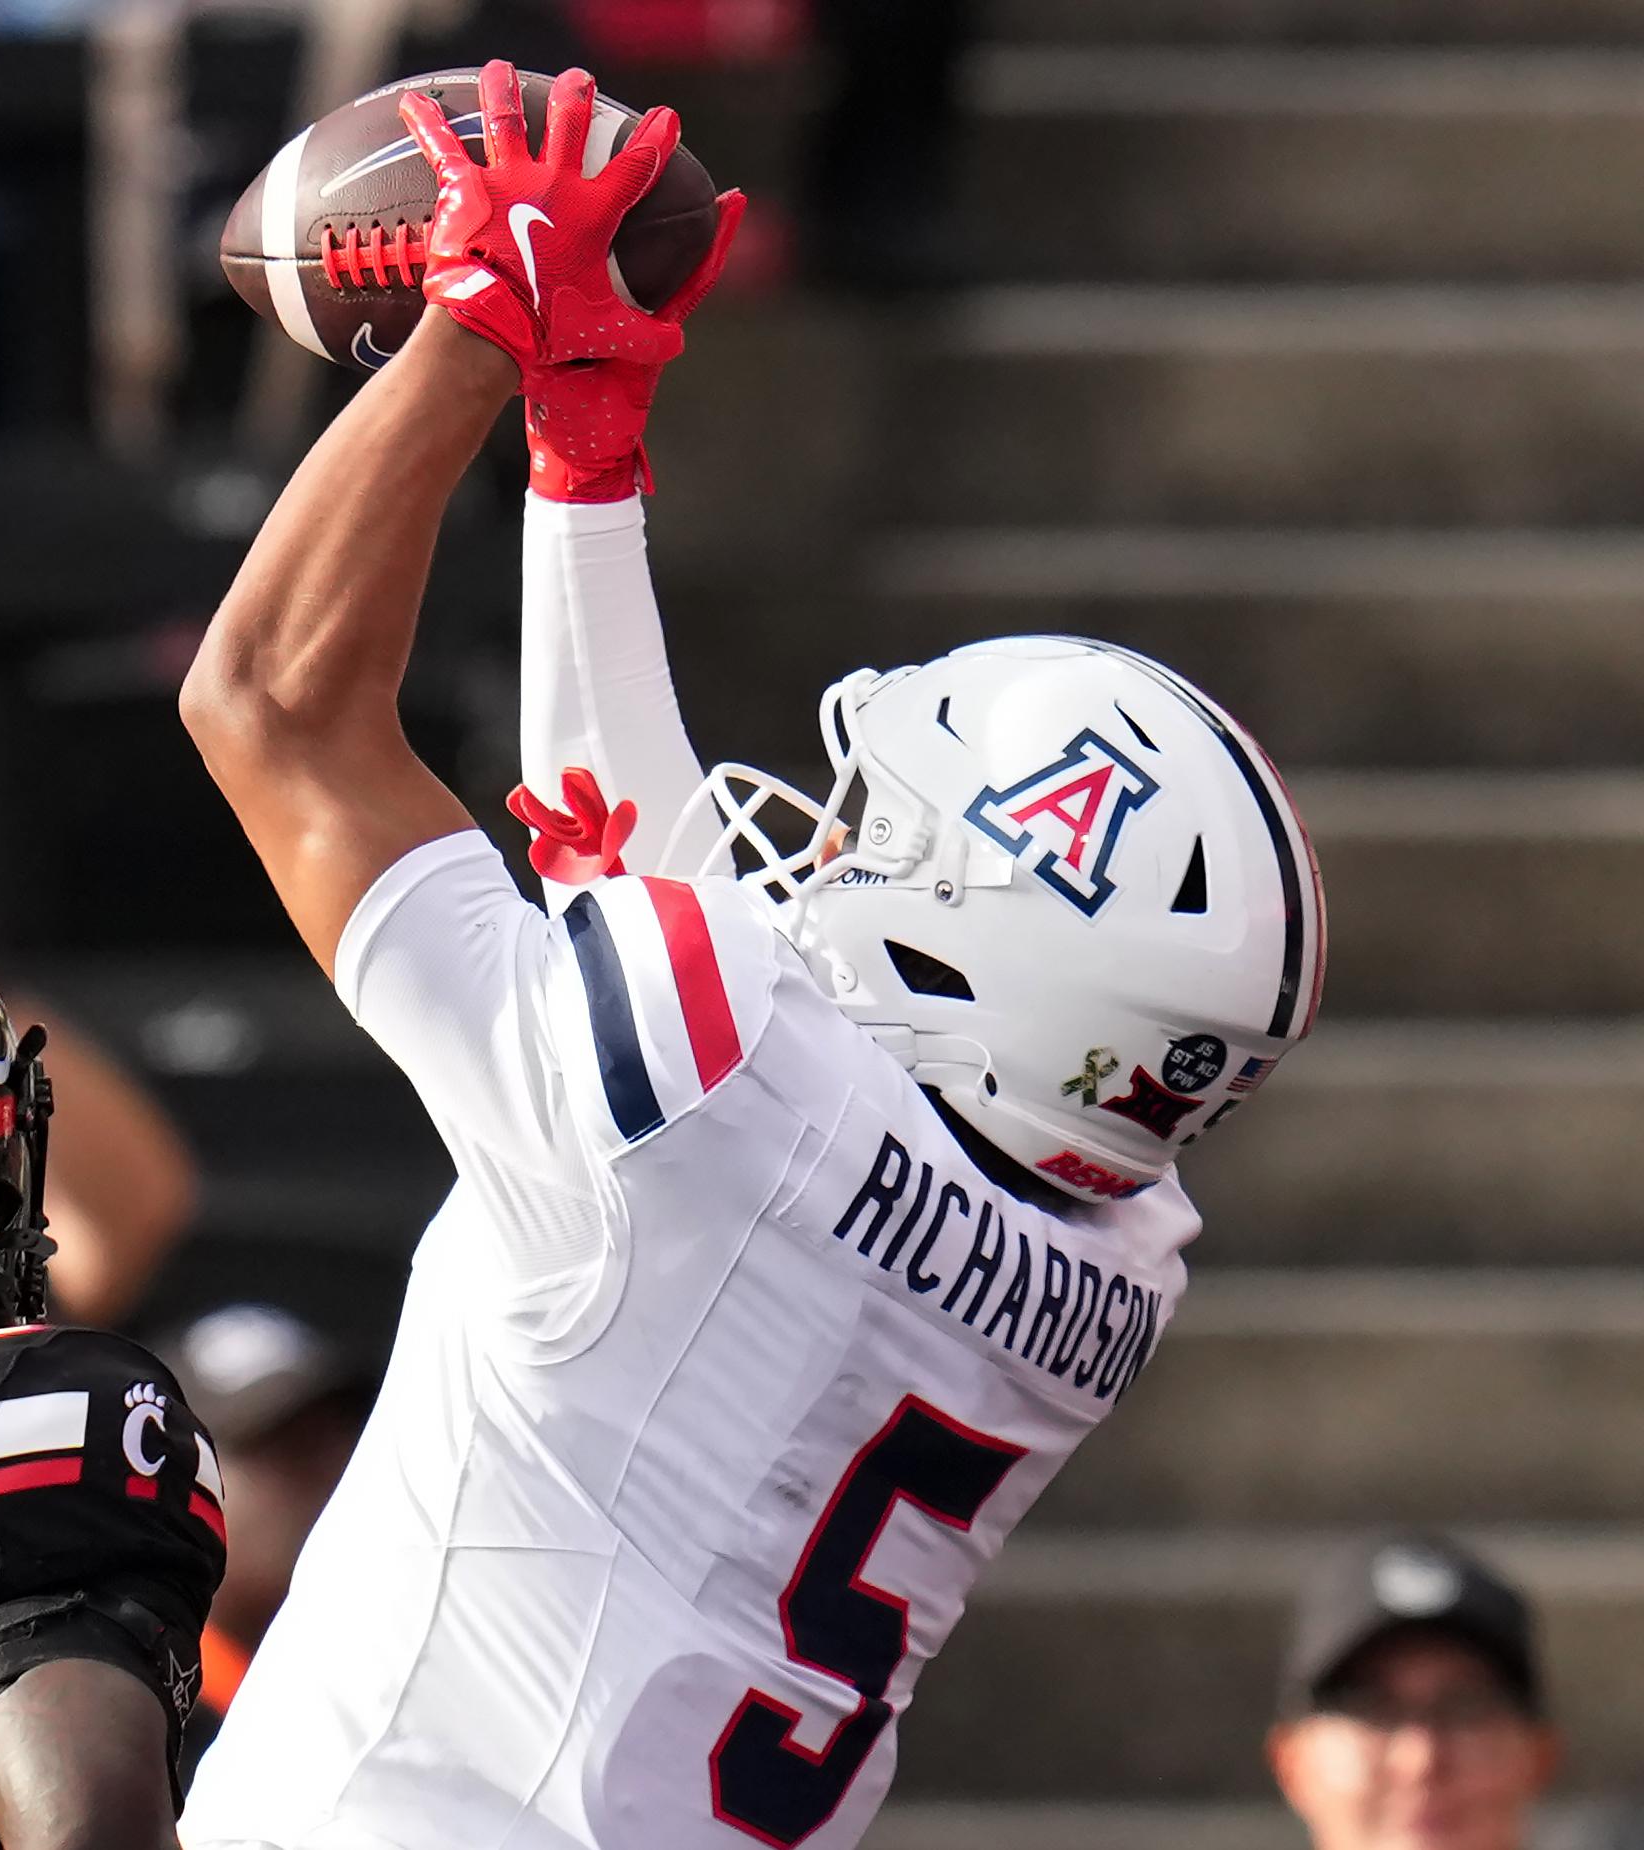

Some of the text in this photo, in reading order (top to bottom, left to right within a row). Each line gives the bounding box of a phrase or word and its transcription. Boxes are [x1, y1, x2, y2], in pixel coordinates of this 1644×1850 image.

[827, 867, 890, 885] OWN
[963, 727, 1160, 918] A
[1170, 1048, 1195, 1068] ST
[832, 1130, 1163, 1406] RICHARDSON
[708, 1393, 1030, 1850] 5
